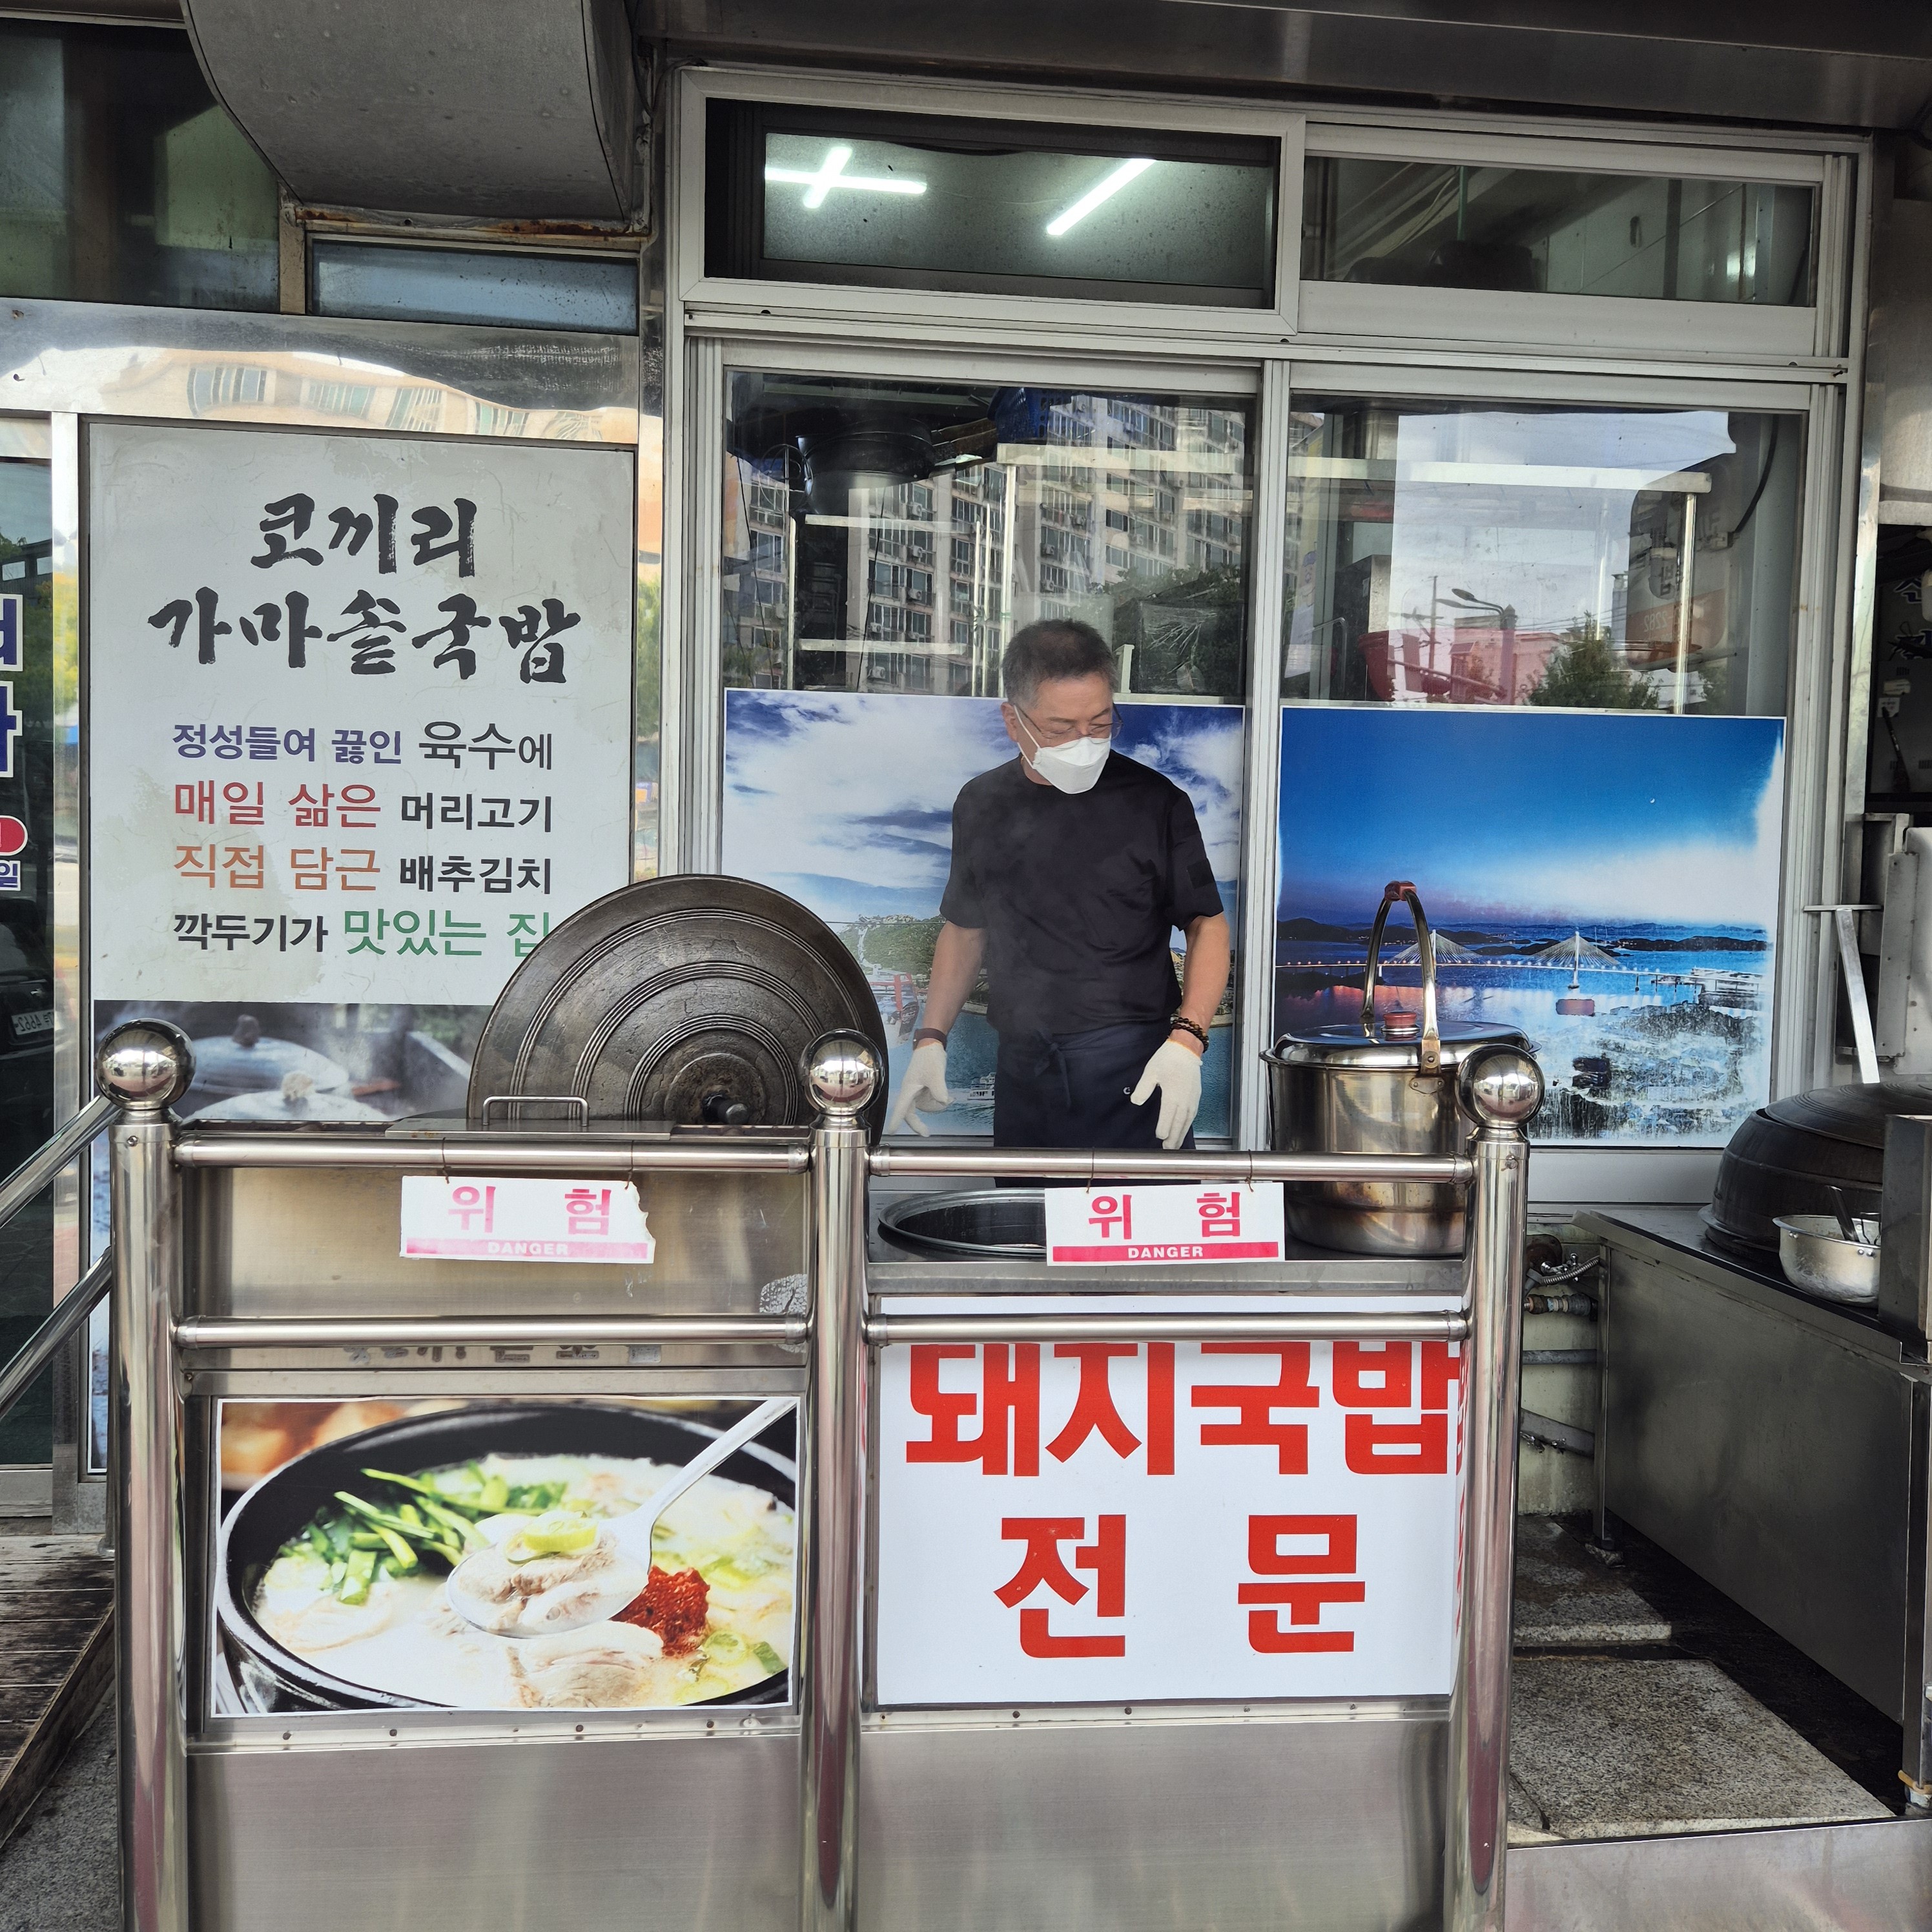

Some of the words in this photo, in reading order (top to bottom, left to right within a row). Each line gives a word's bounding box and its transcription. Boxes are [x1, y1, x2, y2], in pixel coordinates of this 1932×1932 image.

[251, 493, 477, 577] 코끼리
[148, 586, 581, 684] 가마솥국밥
[172, 724, 315, 762] 정성들여
[331, 729, 402, 764] 끓인
[418, 721, 553, 770] 육수에
[174, 780, 265, 826] 매일
[289, 783, 381, 828] 삶은
[401, 792, 552, 833] 머리고기
[174, 845, 265, 890] 직접
[291, 847, 381, 891] 담근
[400, 856, 551, 895] 배추김치
[173, 913, 329, 952] 깍두기가
[344, 909, 487, 956] 맛있는
[507, 912, 550, 957] 집
[488, 1242, 569, 1257] DANGER
[1127, 1246, 1204, 1259] DANGER
[906, 1339, 1461, 1477] 돼지국밥
